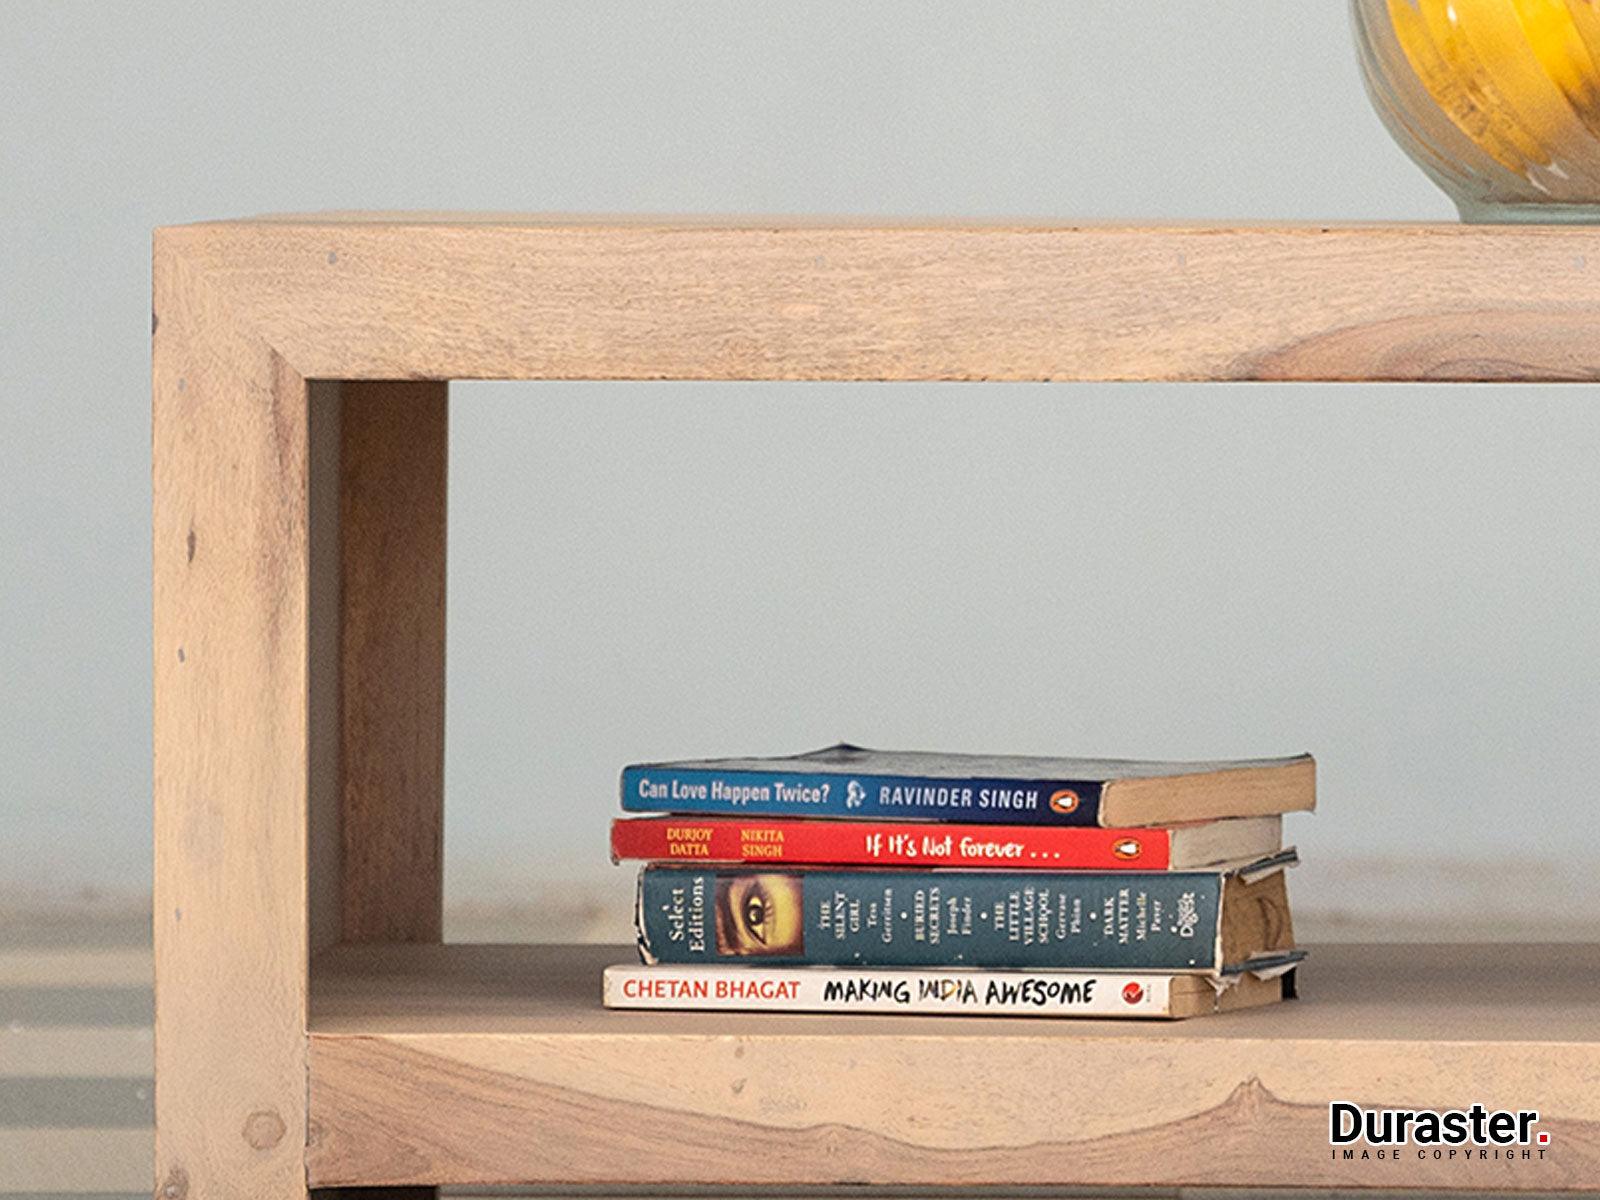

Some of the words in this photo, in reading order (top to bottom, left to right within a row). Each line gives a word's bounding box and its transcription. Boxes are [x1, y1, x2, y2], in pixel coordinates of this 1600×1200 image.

[638, 779, 668, 798] Can
[672, 780, 707, 799] Love
[711, 781, 769, 805] Happen
[774, 783, 829, 803] Twice?
[879, 786, 972, 806] RAVINDER
[979, 789, 1038, 809] SINGH
[667, 828, 714, 841] DURJOY
[671, 844, 709, 855] DATTA
[741, 830, 784, 842] NIKITA
[866, 834, 883, 857] If
[889, 834, 917, 857] It's
[922, 835, 952, 857] Not
[742, 845, 782, 857] SINGH
[669, 889, 685, 941] Select
[688, 876, 705, 952] Editions
[819, 901, 831, 929] THE
[834, 891, 846, 939] SILENT
[850, 899, 860, 933] GIRL
[929, 887, 940, 944] SECRETS
[994, 901, 1005, 931] THE
[1009, 891, 1020, 941] LITTLE
[1024, 886, 1035, 945] VILLAGE
[1038, 888, 1049, 944] SCHOOL
[1104, 896, 1114, 936] DARK
[1119, 888, 1129, 944] MATTER
[623, 979, 708, 998] CHETAN
[715, 980, 800, 999] BHAGAT
[824, 979, 910, 1004] MAKING
[918, 979, 977, 1004] INDIA
[985, 979, 1096, 1006] AWESOME
